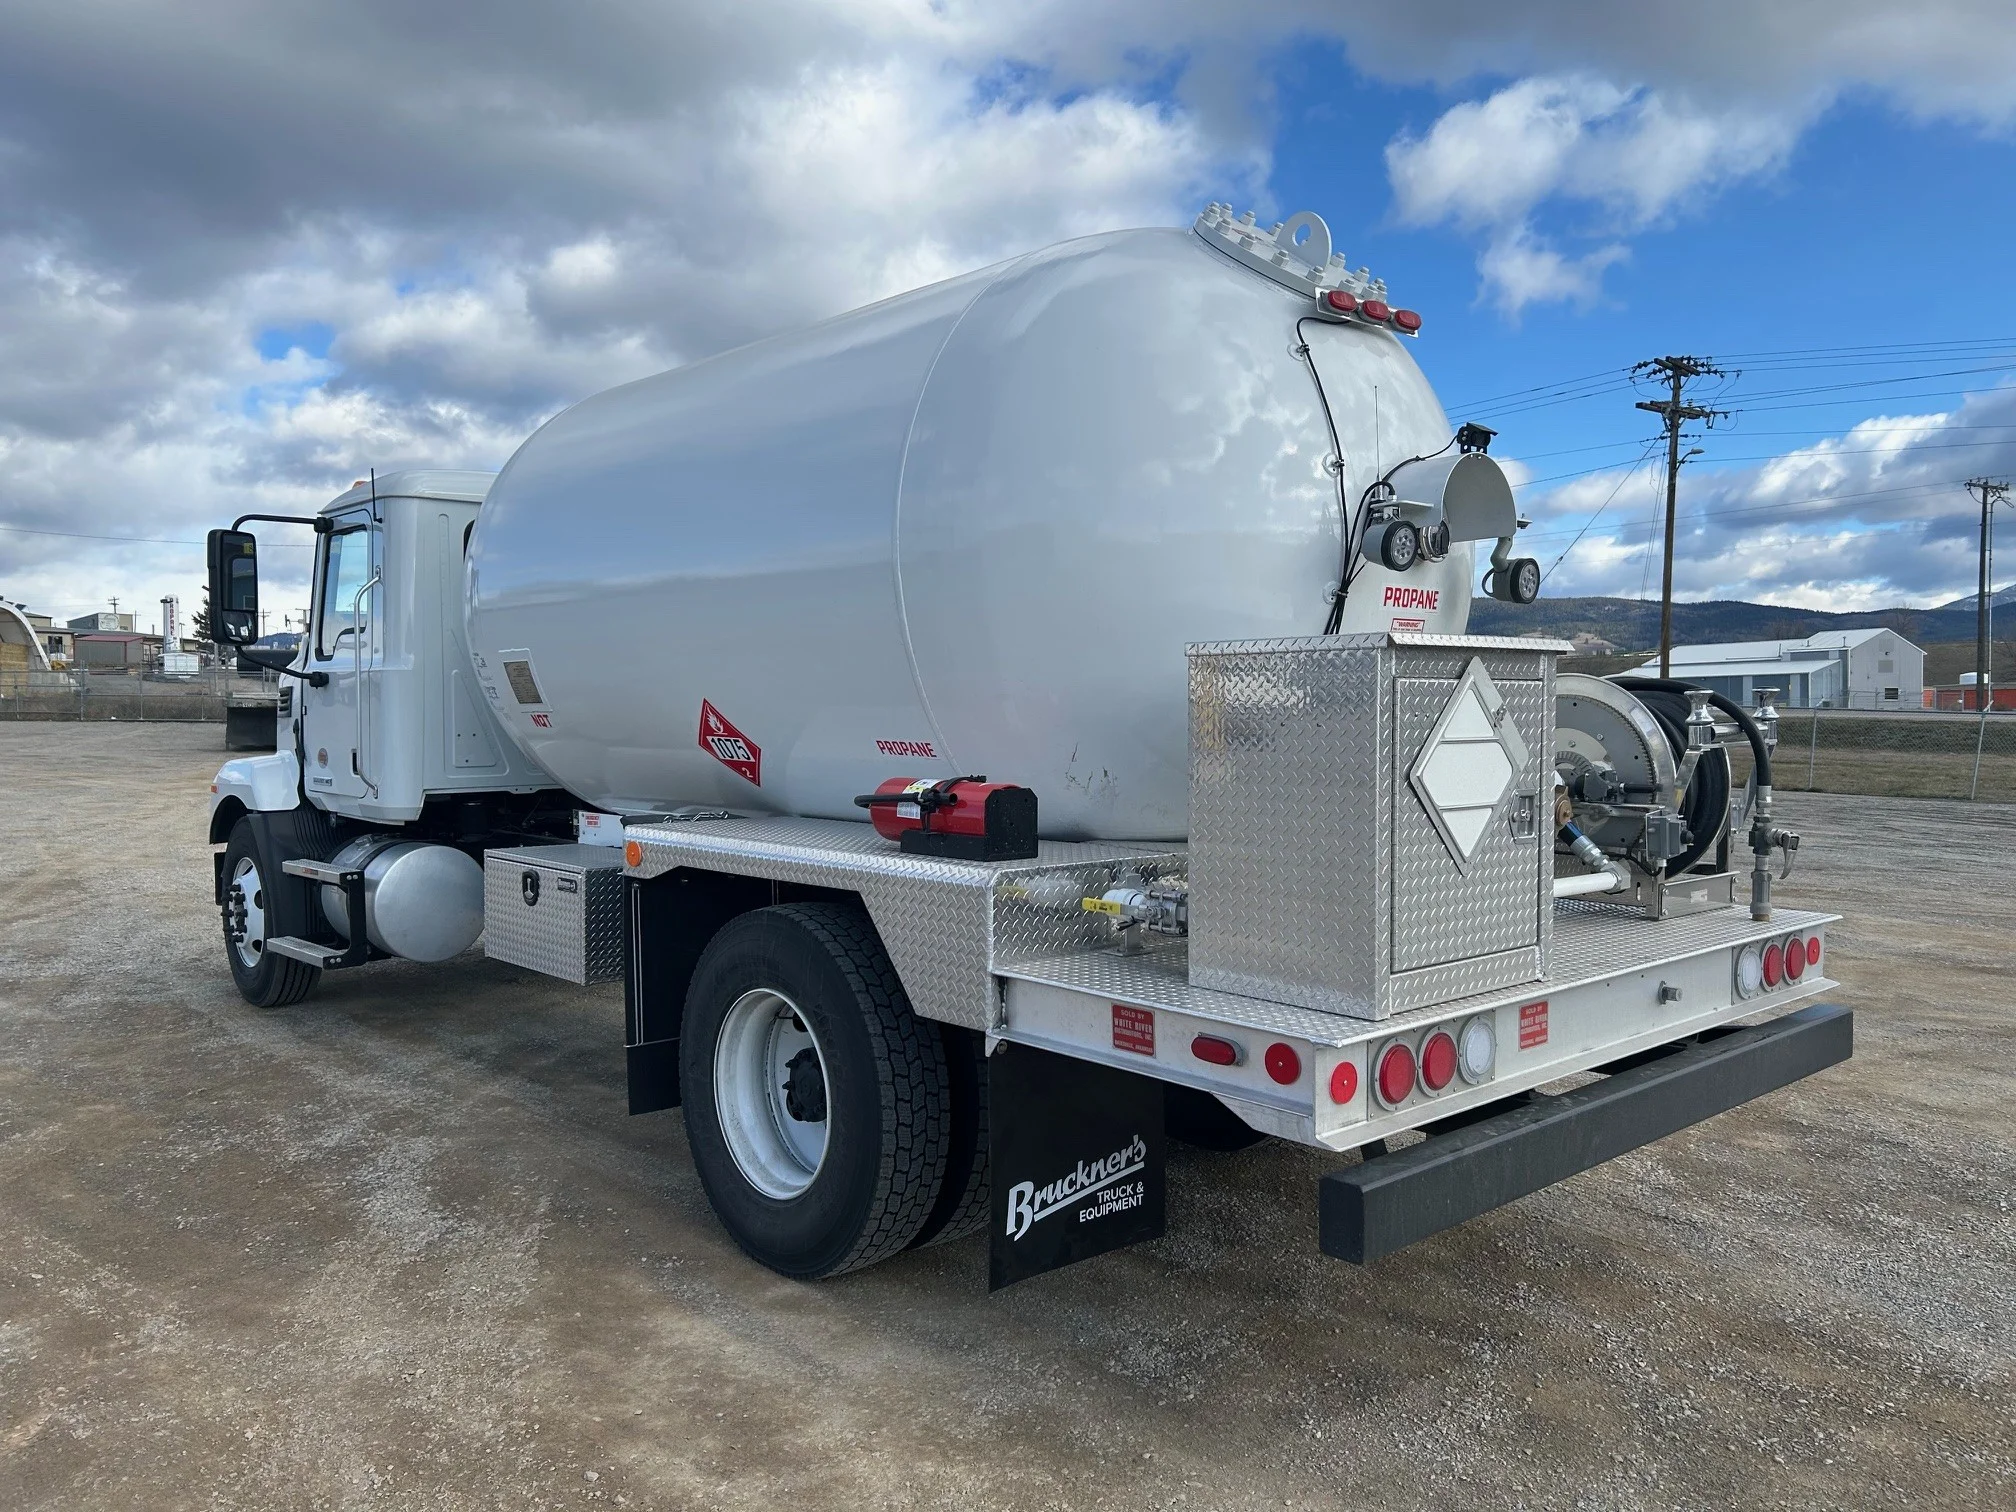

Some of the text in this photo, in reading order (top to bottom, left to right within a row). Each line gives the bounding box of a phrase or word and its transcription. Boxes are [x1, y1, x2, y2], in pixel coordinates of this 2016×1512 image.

[1383, 586, 1439, 609] PROPANE
[530, 714, 553, 728] NQT
[711, 737, 751, 761] 1075
[876, 740, 938, 758] PROPANE
[741, 766, 754, 778] 2
[1120, 1009, 1145, 1020] SOLD BY
[1114, 1017, 1153, 1034] WHITE RIVER
[1006, 1134, 1147, 1242] Bruckner's
[1097, 1181, 1144, 1204] TRUCK &
[1079, 1194, 1144, 1223] EQUIPMENT
